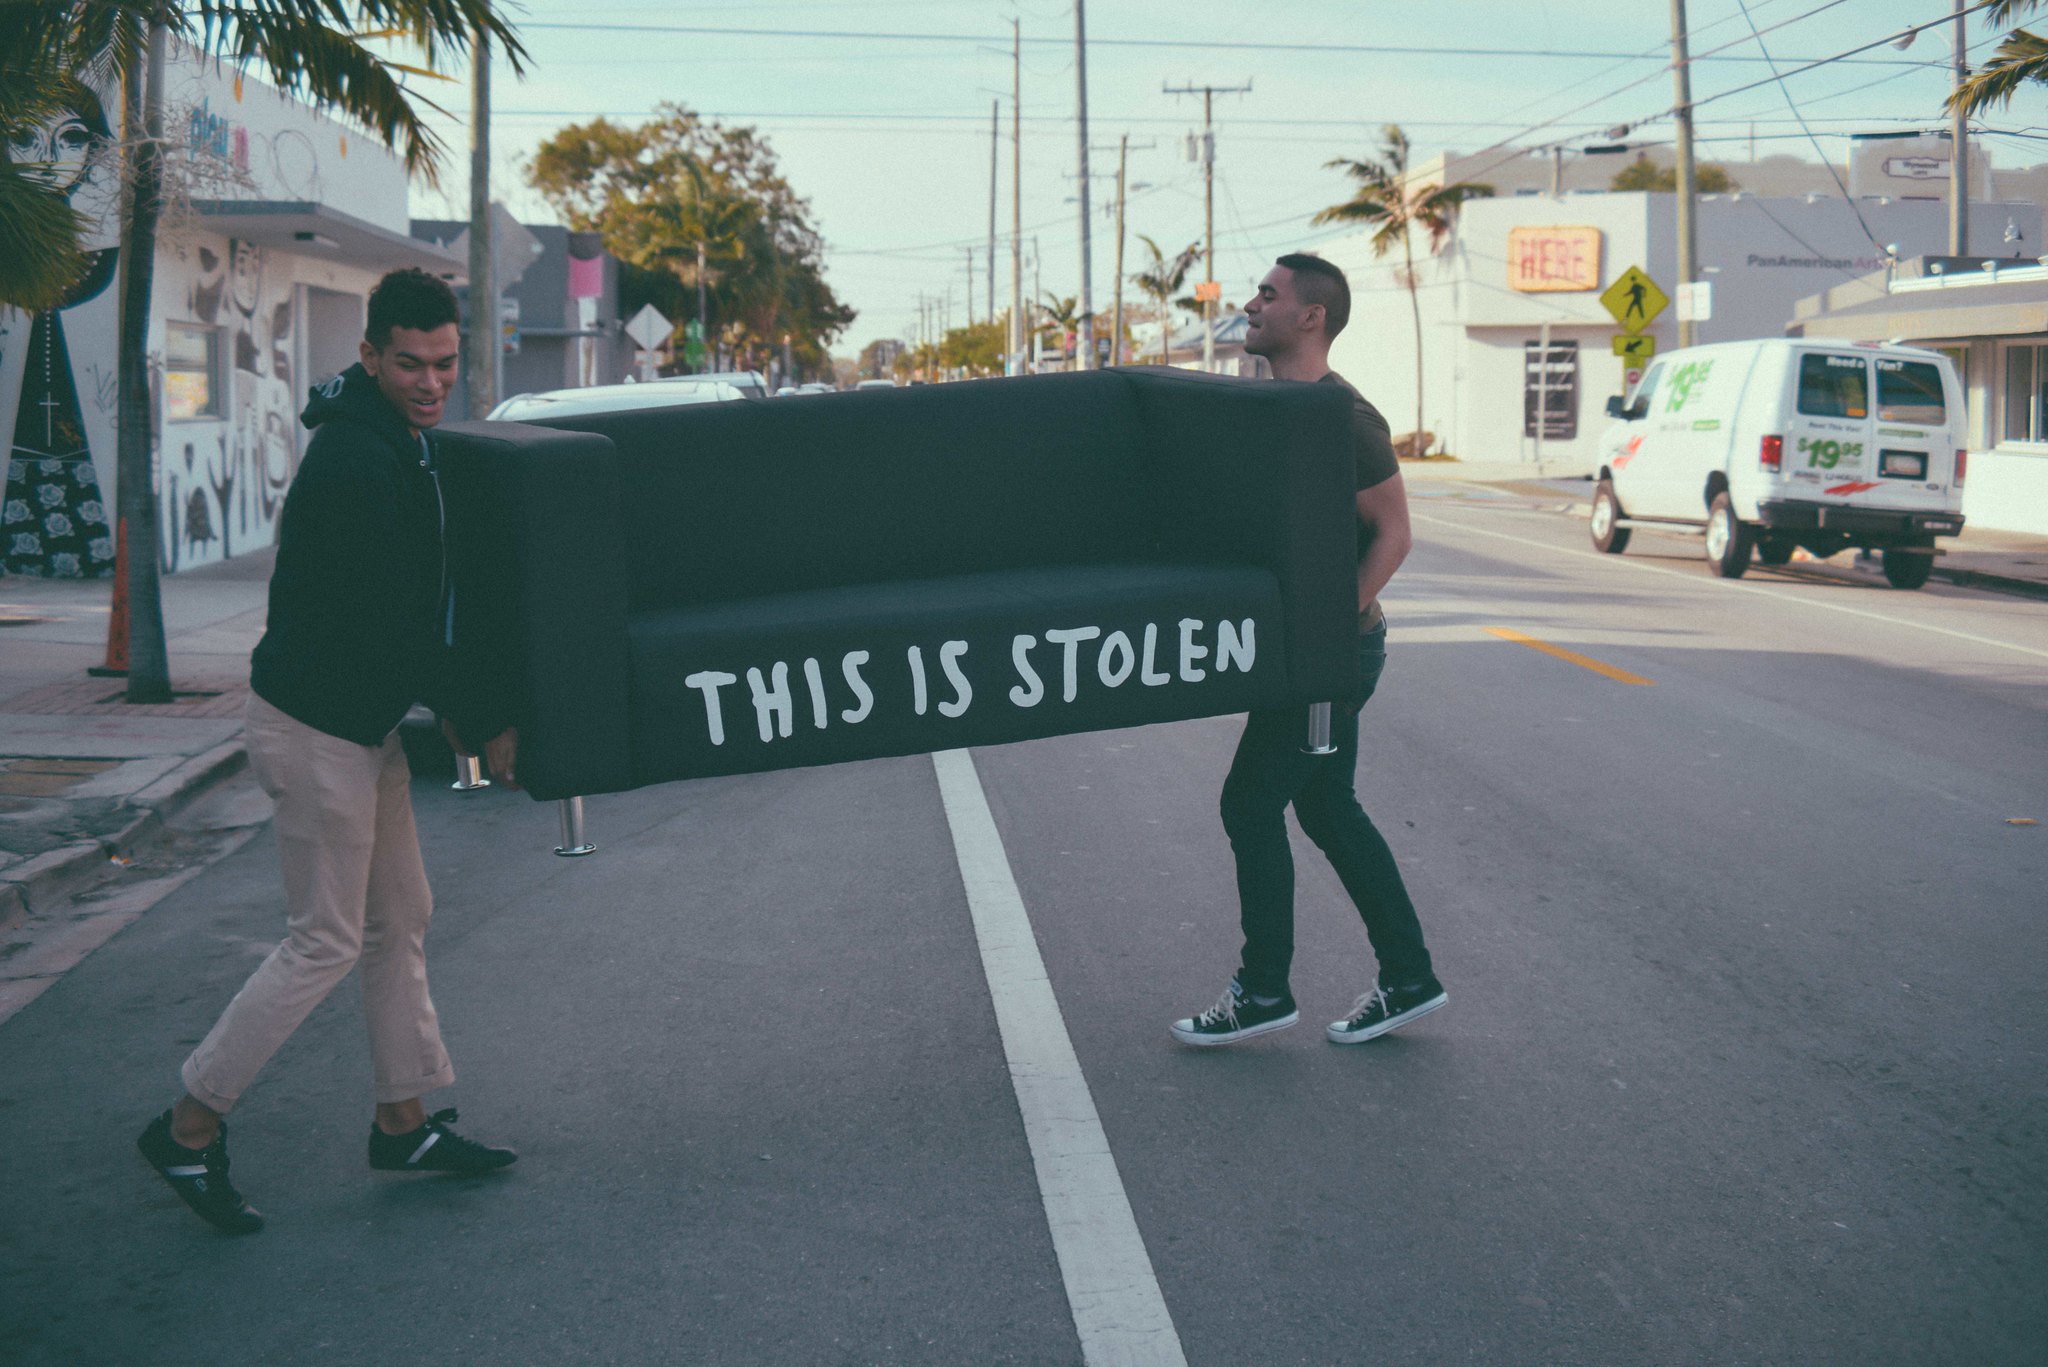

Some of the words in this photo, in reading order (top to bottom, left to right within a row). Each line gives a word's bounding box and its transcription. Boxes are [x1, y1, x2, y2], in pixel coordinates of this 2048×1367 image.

[1520, 238, 1585, 279] HERE
[1747, 254, 1852, 268] PanAmerican
[1826, 356, 1855, 368] Need
[1876, 359, 1904, 371] Van?
[685, 650, 874, 747] THIS
[907, 640, 972, 718] IS
[1009, 617, 1256, 708] STOLEN
